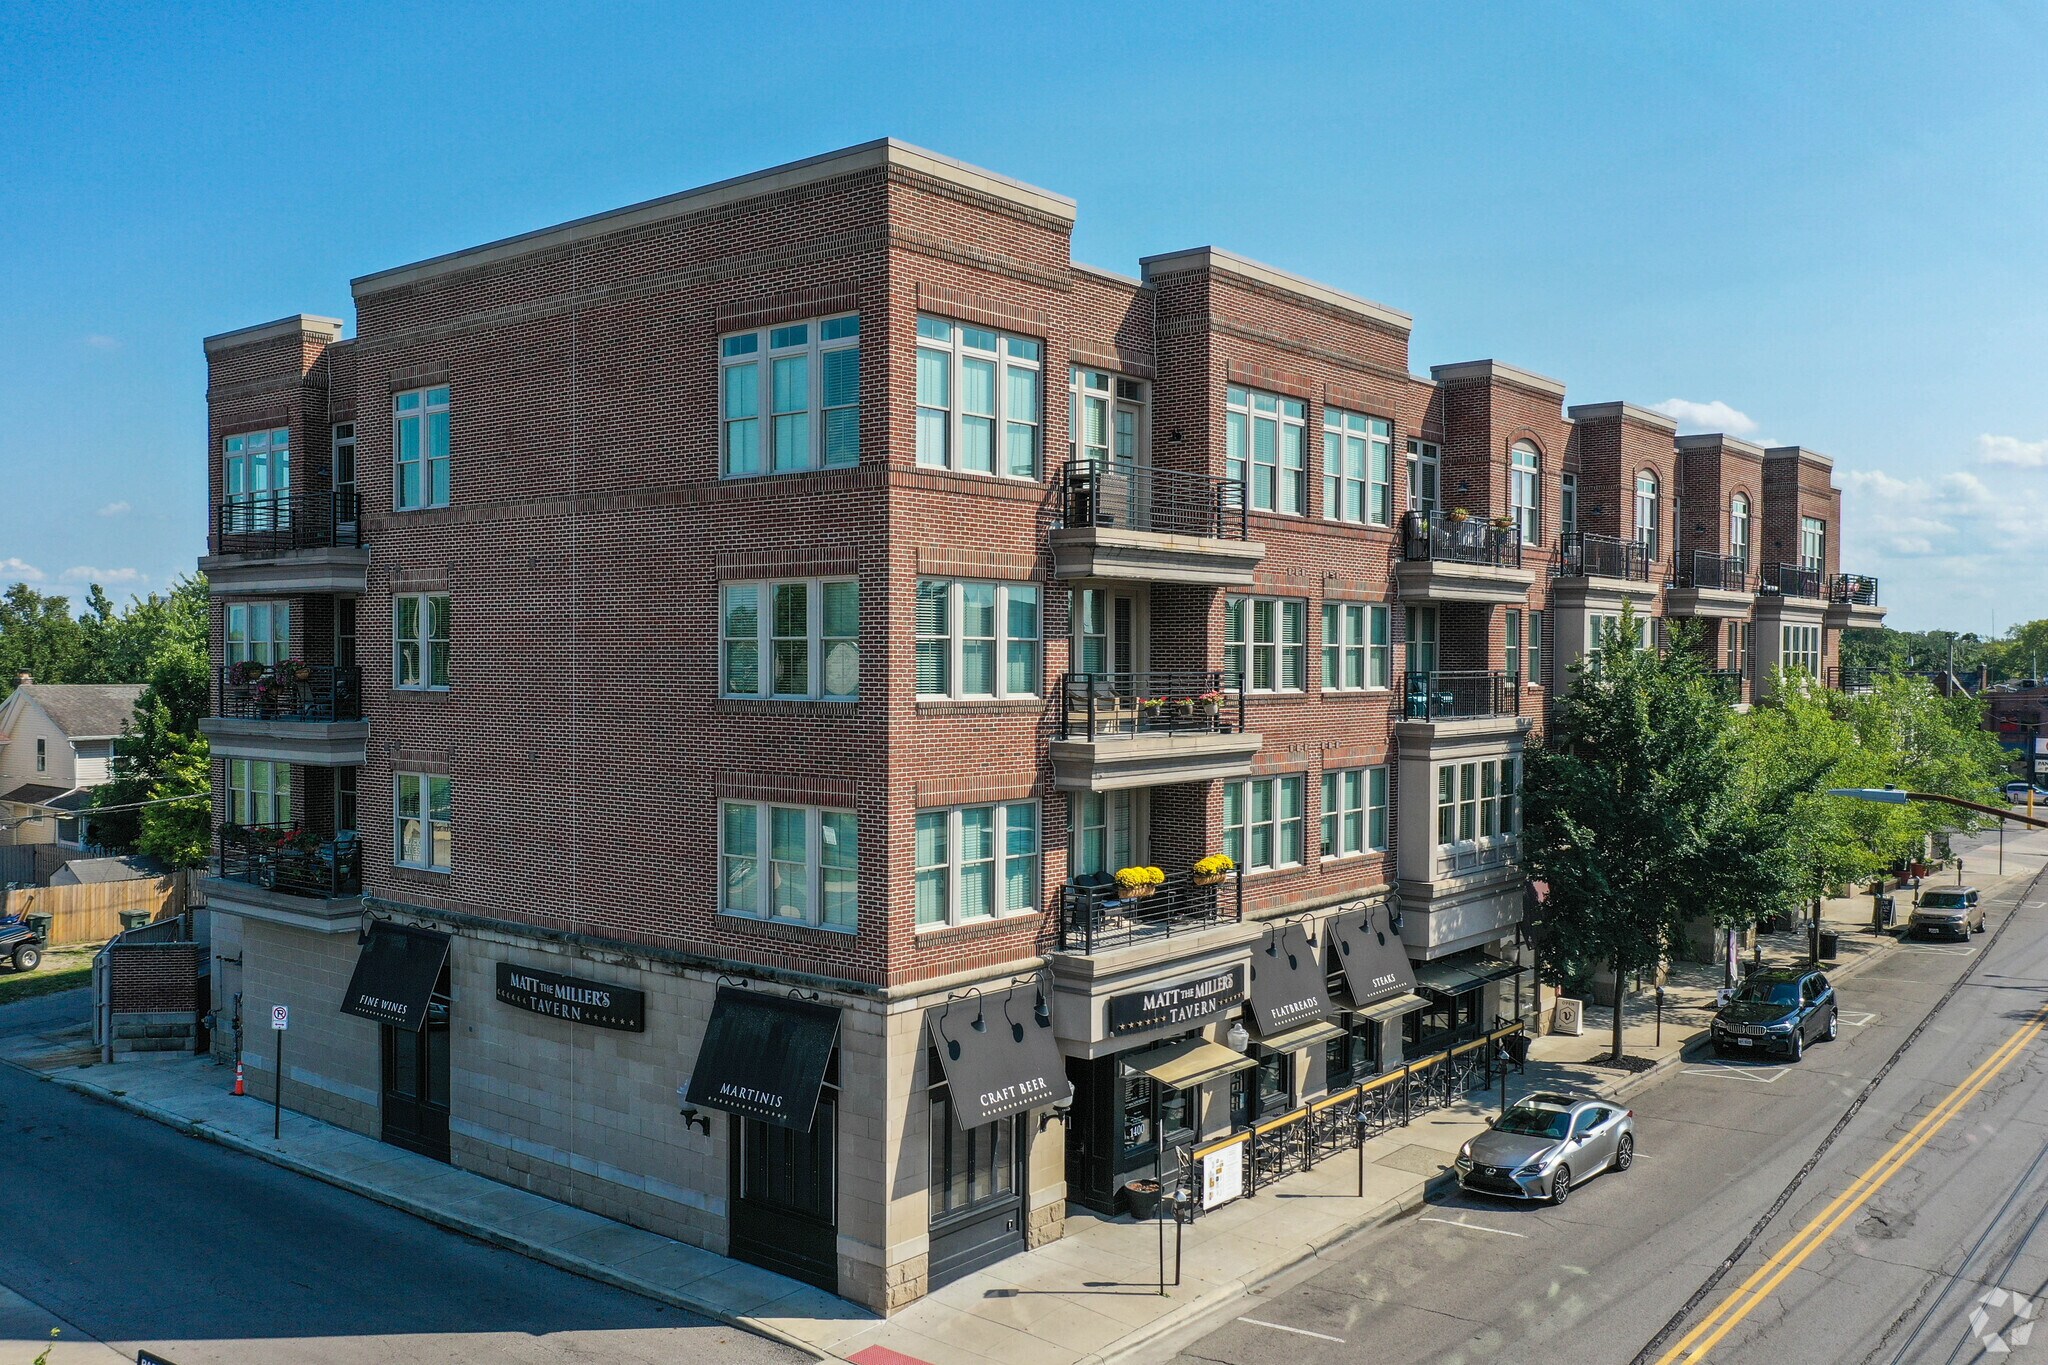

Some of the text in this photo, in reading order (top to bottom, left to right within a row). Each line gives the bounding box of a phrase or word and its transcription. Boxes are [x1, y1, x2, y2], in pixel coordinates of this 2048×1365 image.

[510, 972, 611, 1008] MATT THE MILLER'S
[1143, 973, 1234, 1011] MATT THE MILLER'S
[1372, 973, 1396, 988] STEAKS
[359, 994, 408, 1015] FINE WINES
[530, 996, 581, 1020] TAVERN
[1169, 998, 1216, 1023] TAVERN
[1270, 996, 1318, 1019] FLATBREADS
[720, 1082, 783, 1108] MARTINIS
[980, 1077, 1047, 1107] CRAFT BEER
[1129, 1123, 1145, 1139] 1400
